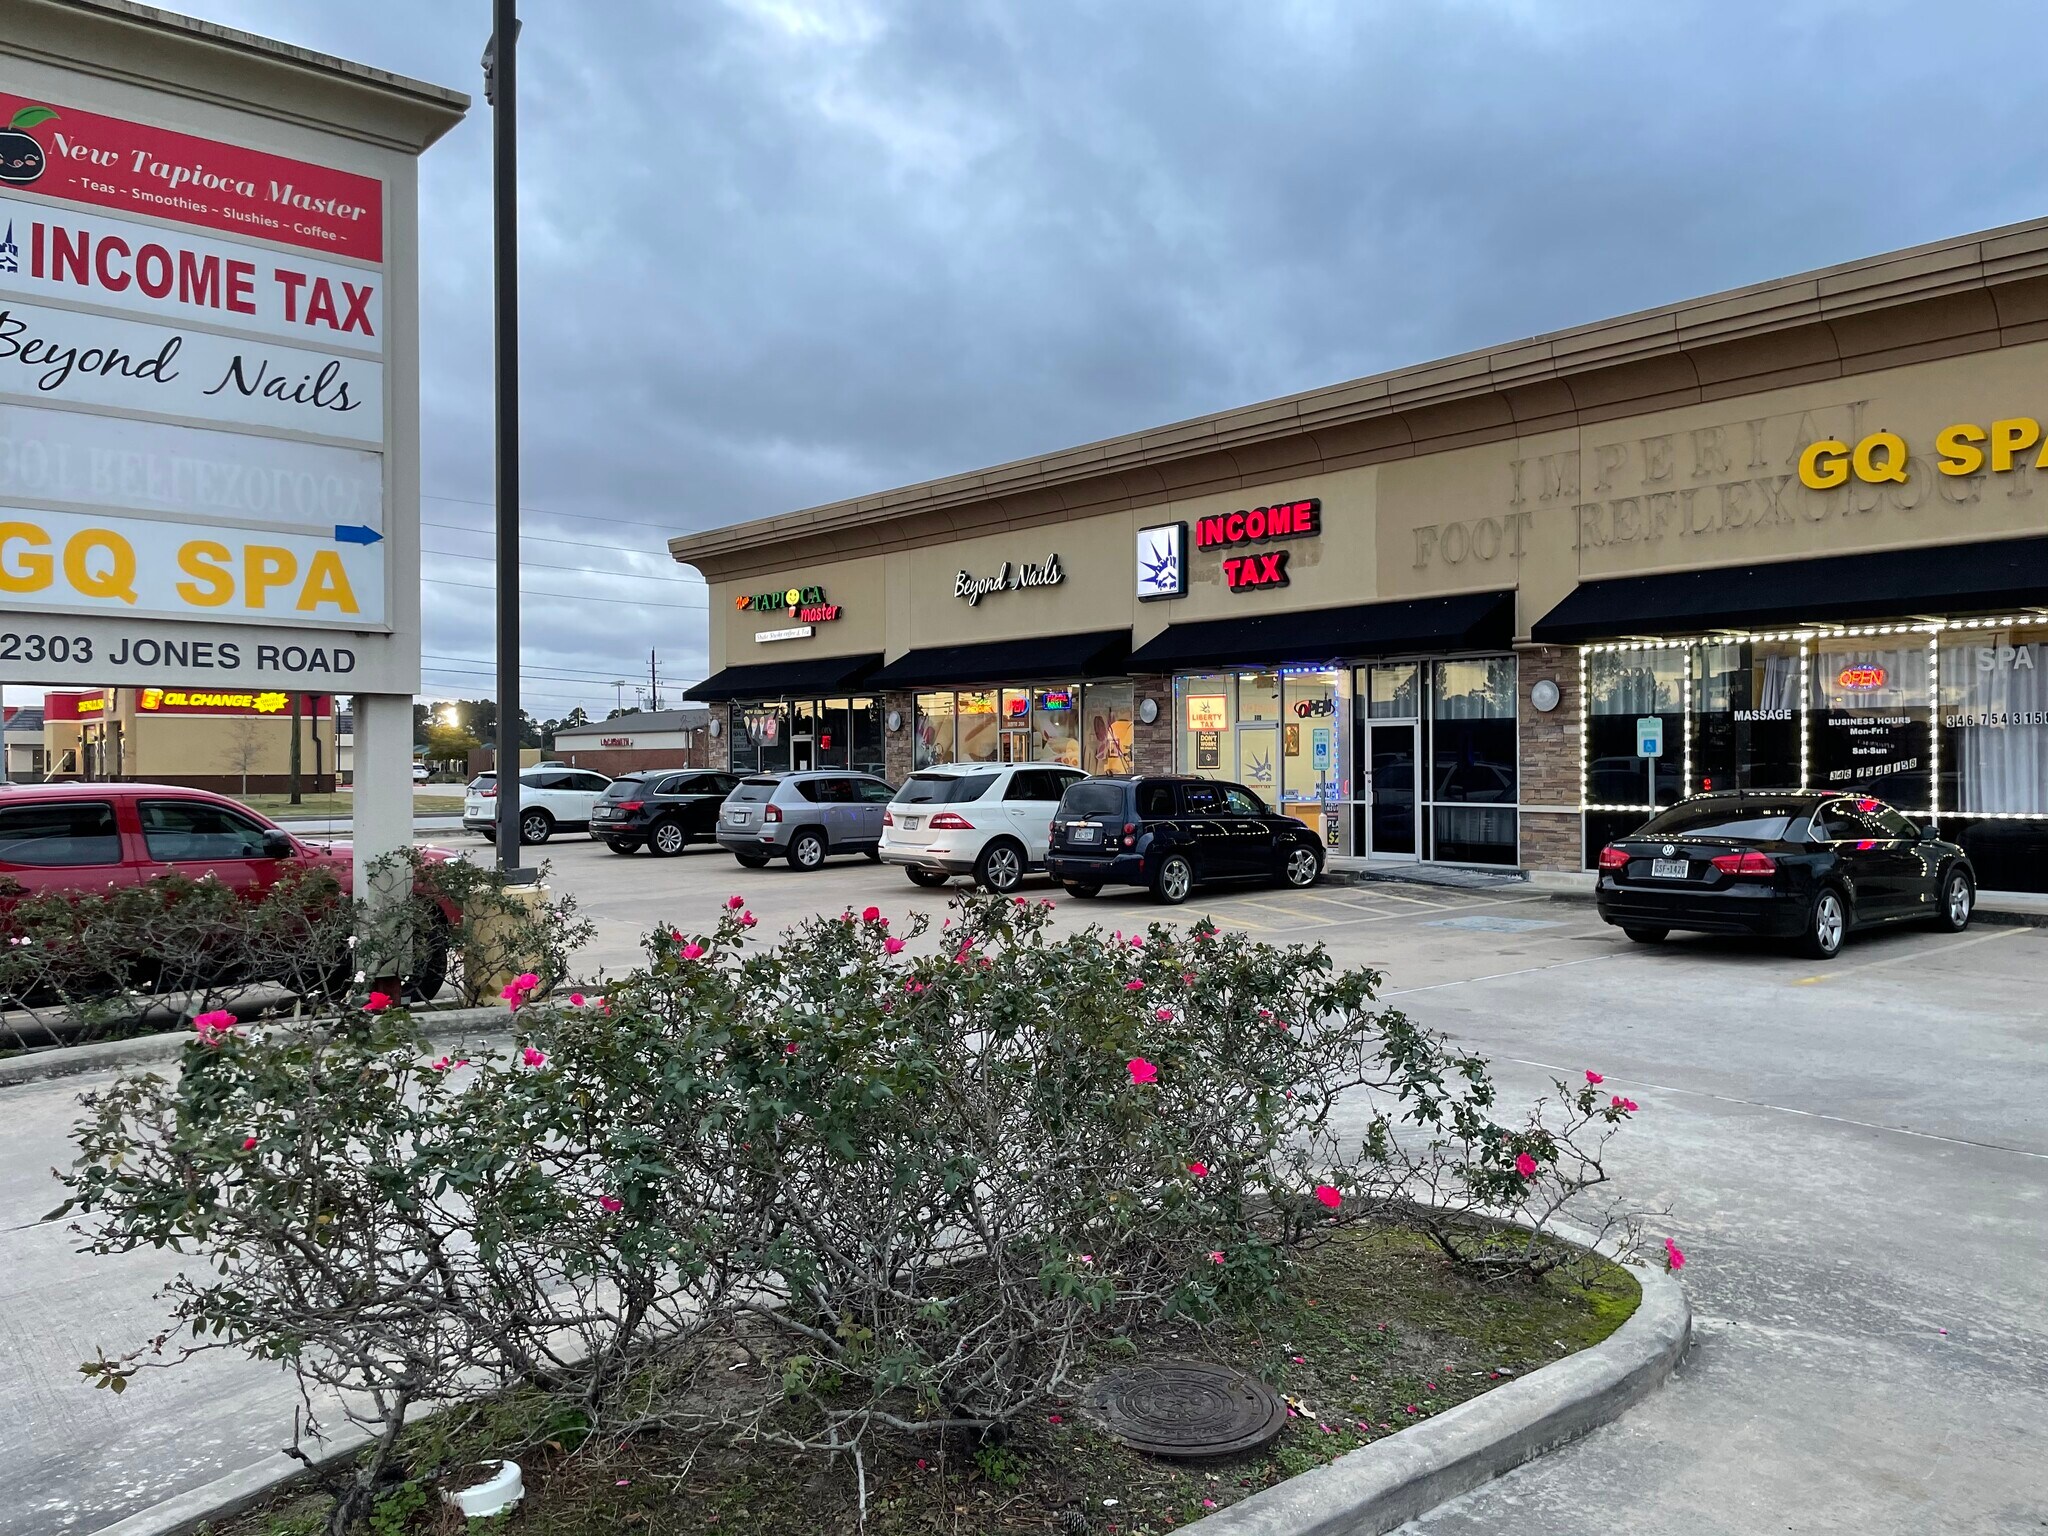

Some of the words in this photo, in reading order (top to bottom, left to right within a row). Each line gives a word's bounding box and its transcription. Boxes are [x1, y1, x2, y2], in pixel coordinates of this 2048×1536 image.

[49, 132, 118, 167] New
[130, 150, 256, 198] Tapioca
[264, 179, 367, 221] Master
[81, 177, 115, 194] Teas
[131, 187, 208, 213] Smoothies
[223, 207, 279, 228] Slushies
[293, 222, 337, 241] Coffee
[31, 221, 257, 315] INCOME
[274, 268, 375, 337] TAX
[0, 310, 182, 391] Beyond
[203, 355, 362, 412] Nails
[1798, 432, 1910, 489] GQ
[1935, 417, 2048, 476] SP
[1196, 501, 1312, 547] INCOME
[1412, 511, 1534, 569] FOOT
[0, 521, 138, 605] GQ
[175, 540, 361, 614] SPA
[954, 561, 1007, 606] Beyond
[1011, 553, 1062, 590] Nails
[1222, 553, 1280, 587] TAX
[800, 603, 838, 622] master
[109, 638, 240, 669] JONES
[257, 644, 356, 673] ROAD
[1978, 646, 2034, 671] SPA
[1839, 669, 1884, 687] OPEN
[164, 692, 189, 706] OIL
[190, 693, 253, 708] CHANGE
[1733, 708, 1792, 721] MASSAGE
[1192, 713, 1222, 721] LIBERTY
[1828, 717, 1875, 726] BUSINESS
[1877, 716, 1911, 724] HOURS
[1946, 714, 1974, 727] 346
[1980, 712, 2009, 726] 754
[1852, 746, 1888, 755] Sat-Sun
[1315, 782, 1336, 791] NTARY
[1829, 769, 1852, 781] 346
